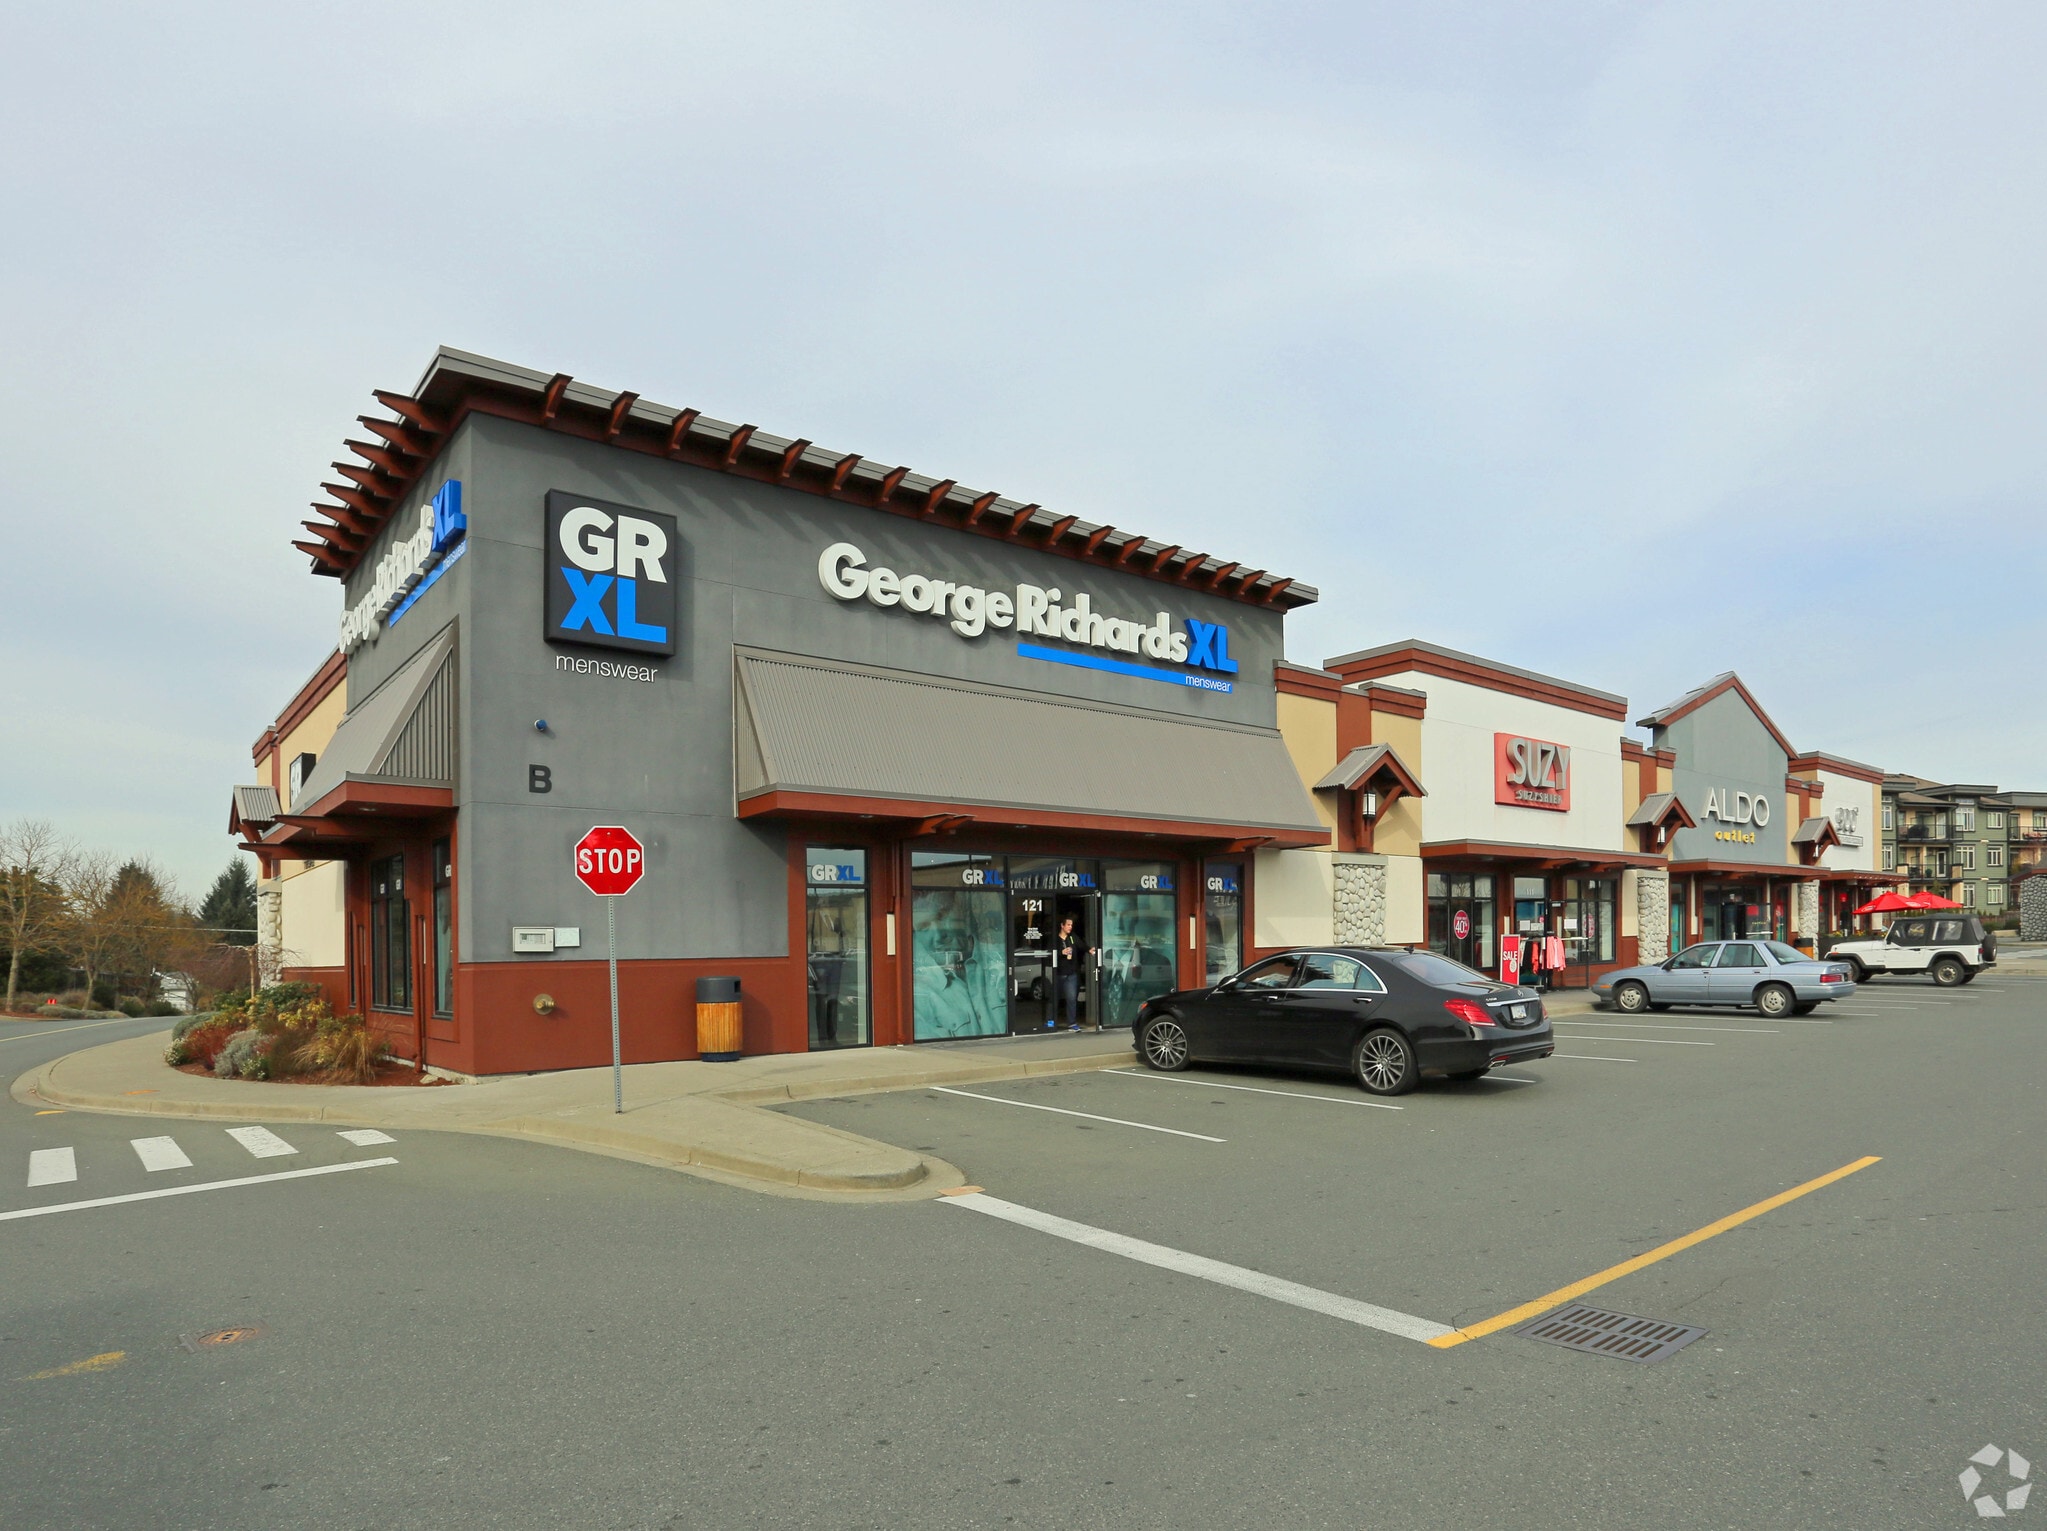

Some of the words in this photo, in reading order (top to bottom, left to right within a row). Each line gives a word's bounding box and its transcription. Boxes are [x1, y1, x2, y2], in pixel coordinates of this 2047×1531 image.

[559, 506, 668, 583] GR
[560, 566, 667, 644] XL
[555, 654, 658, 682] menswear
[1185, 674, 1232, 692] menswear
[1506, 738, 1571, 790] SUZY
[529, 764, 552, 793] B
[1701, 787, 1770, 827] ALDO
[1715, 829, 1756, 844] outlet
[579, 848, 641, 874] STOP
[1022, 899, 1043, 912] 121
[1503, 950, 1518, 961] SALE
